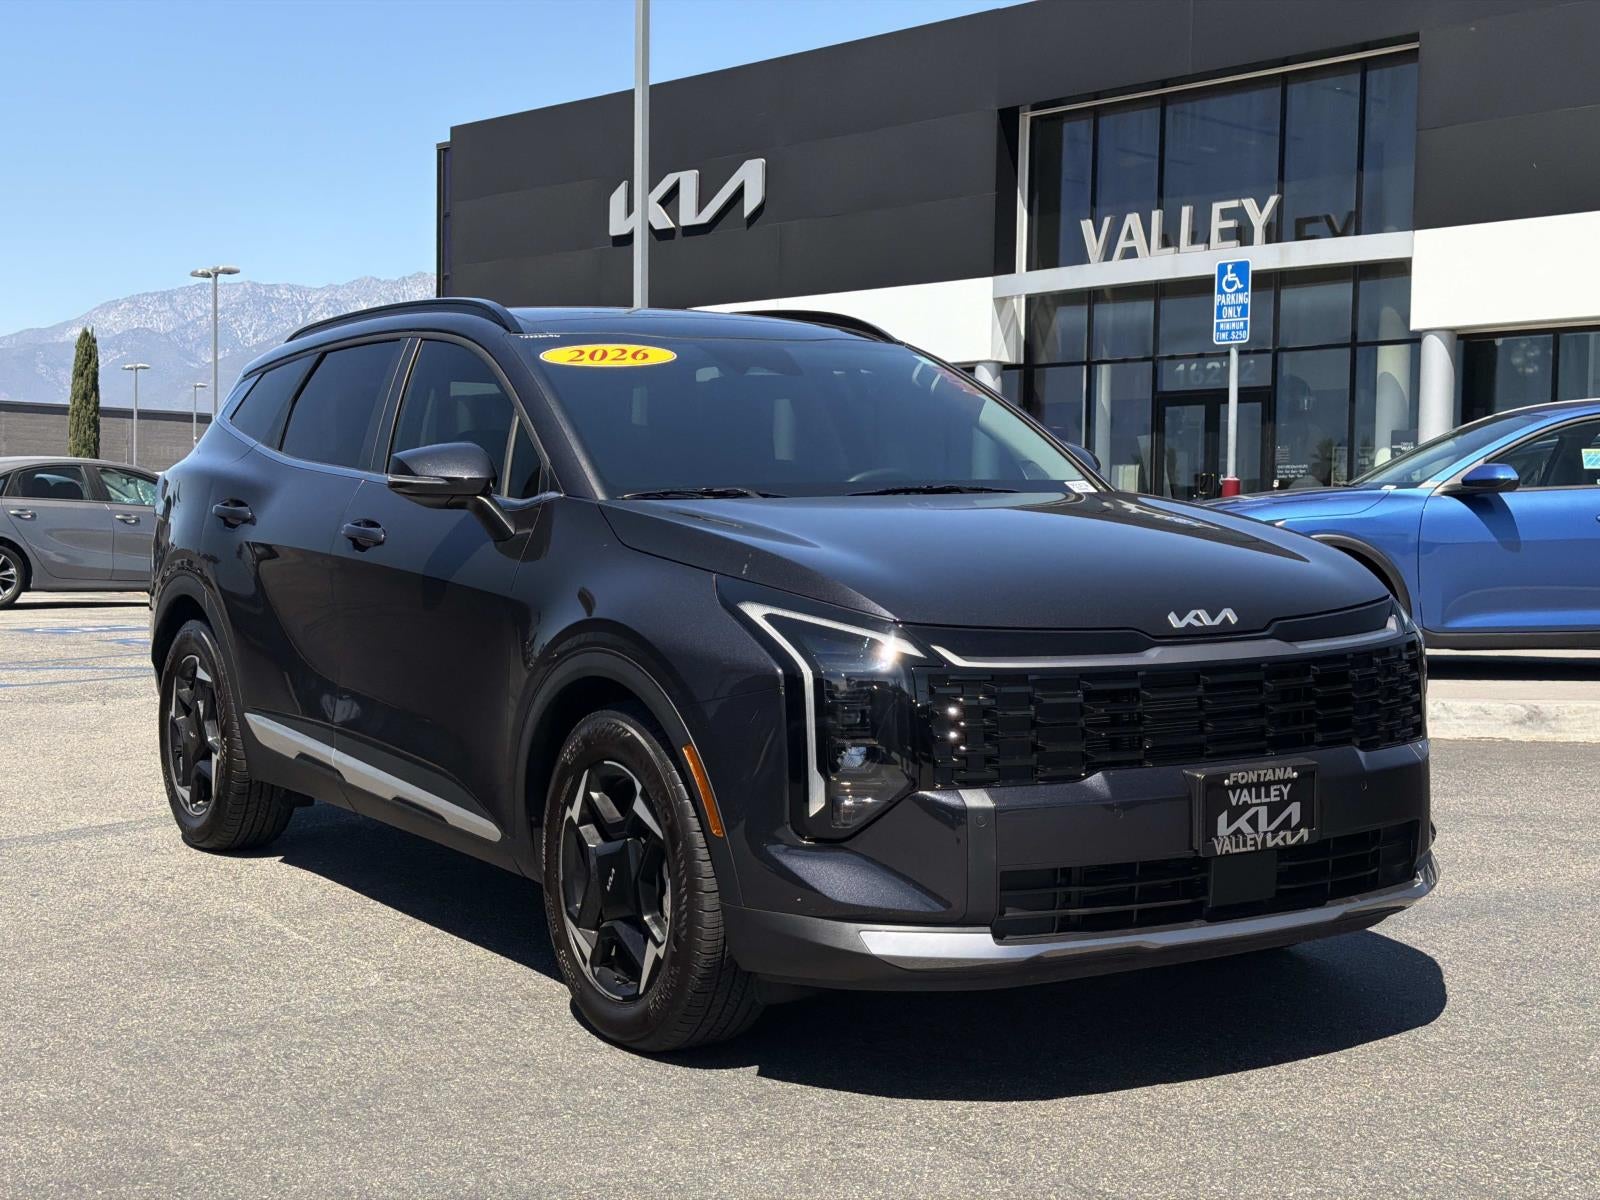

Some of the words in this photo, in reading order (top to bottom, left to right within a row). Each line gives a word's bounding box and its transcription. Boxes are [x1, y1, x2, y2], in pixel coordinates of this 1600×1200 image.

[1080, 193, 1282, 264] VALLEY
[1216, 292, 1248, 306] PARKING
[1222, 306, 1242, 318] ONLY
[1219, 321, 1244, 330] MINIMUM
[1216, 331, 1229, 341] FINE
[1231, 330, 1247, 340] $250
[568, 348, 649, 362] 2026
[1167, 607, 1239, 628] KIA
[1229, 767, 1293, 784] FONTANA
[1228, 783, 1292, 806] VALLEY
[1217, 801, 1301, 837] KIA
[1212, 832, 1264, 855] VALLEY
[1266, 827, 1309, 848] KIA
